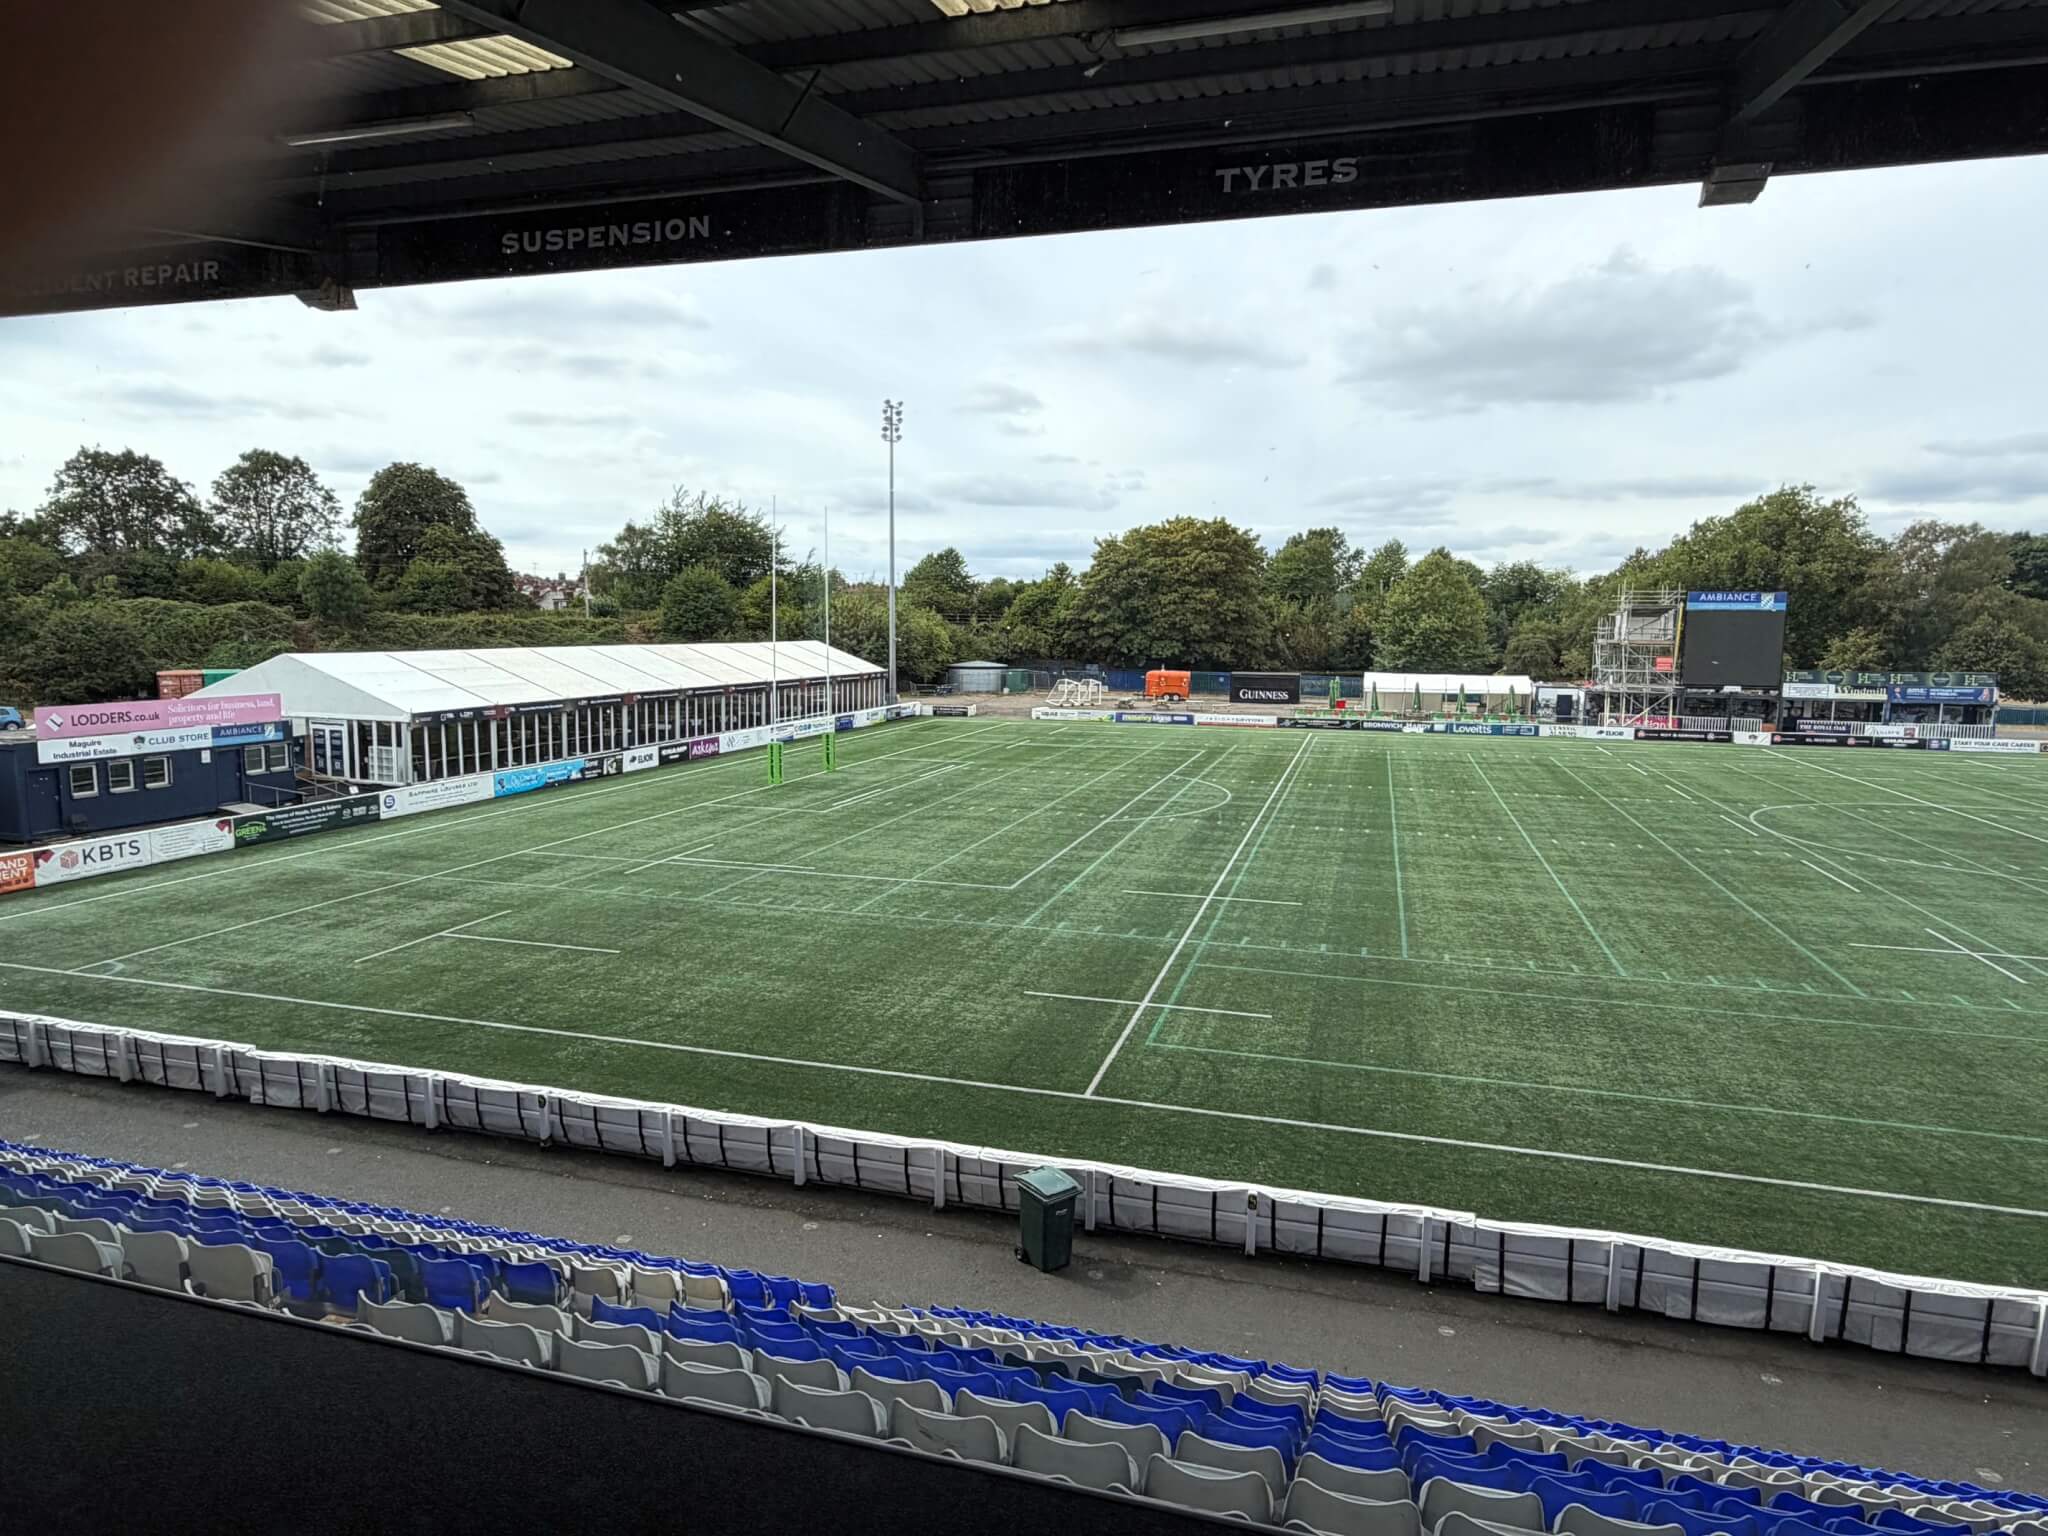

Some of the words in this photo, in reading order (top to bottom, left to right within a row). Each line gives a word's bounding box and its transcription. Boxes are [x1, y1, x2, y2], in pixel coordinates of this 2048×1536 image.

[1215, 157, 1359, 193] TYRES
[501, 215, 710, 254] SUSPENSION
[123, 260, 220, 287] REPAIR
[1699, 592, 1758, 601] AMBIANCE
[1239, 688, 1289, 700] GUINNESS
[70, 711, 160, 727] LODDERS.co.uk
[219, 726, 262, 737] AMBIANCE
[1453, 723, 1493, 734] Loveitts
[68, 740, 102, 749] Maguire
[148, 735, 176, 746] CLUB
[178, 732, 210, 743] STORE
[53, 750, 91, 760] Industrial
[93, 748, 118, 756] Estate
[82, 839, 141, 865] KBTS
